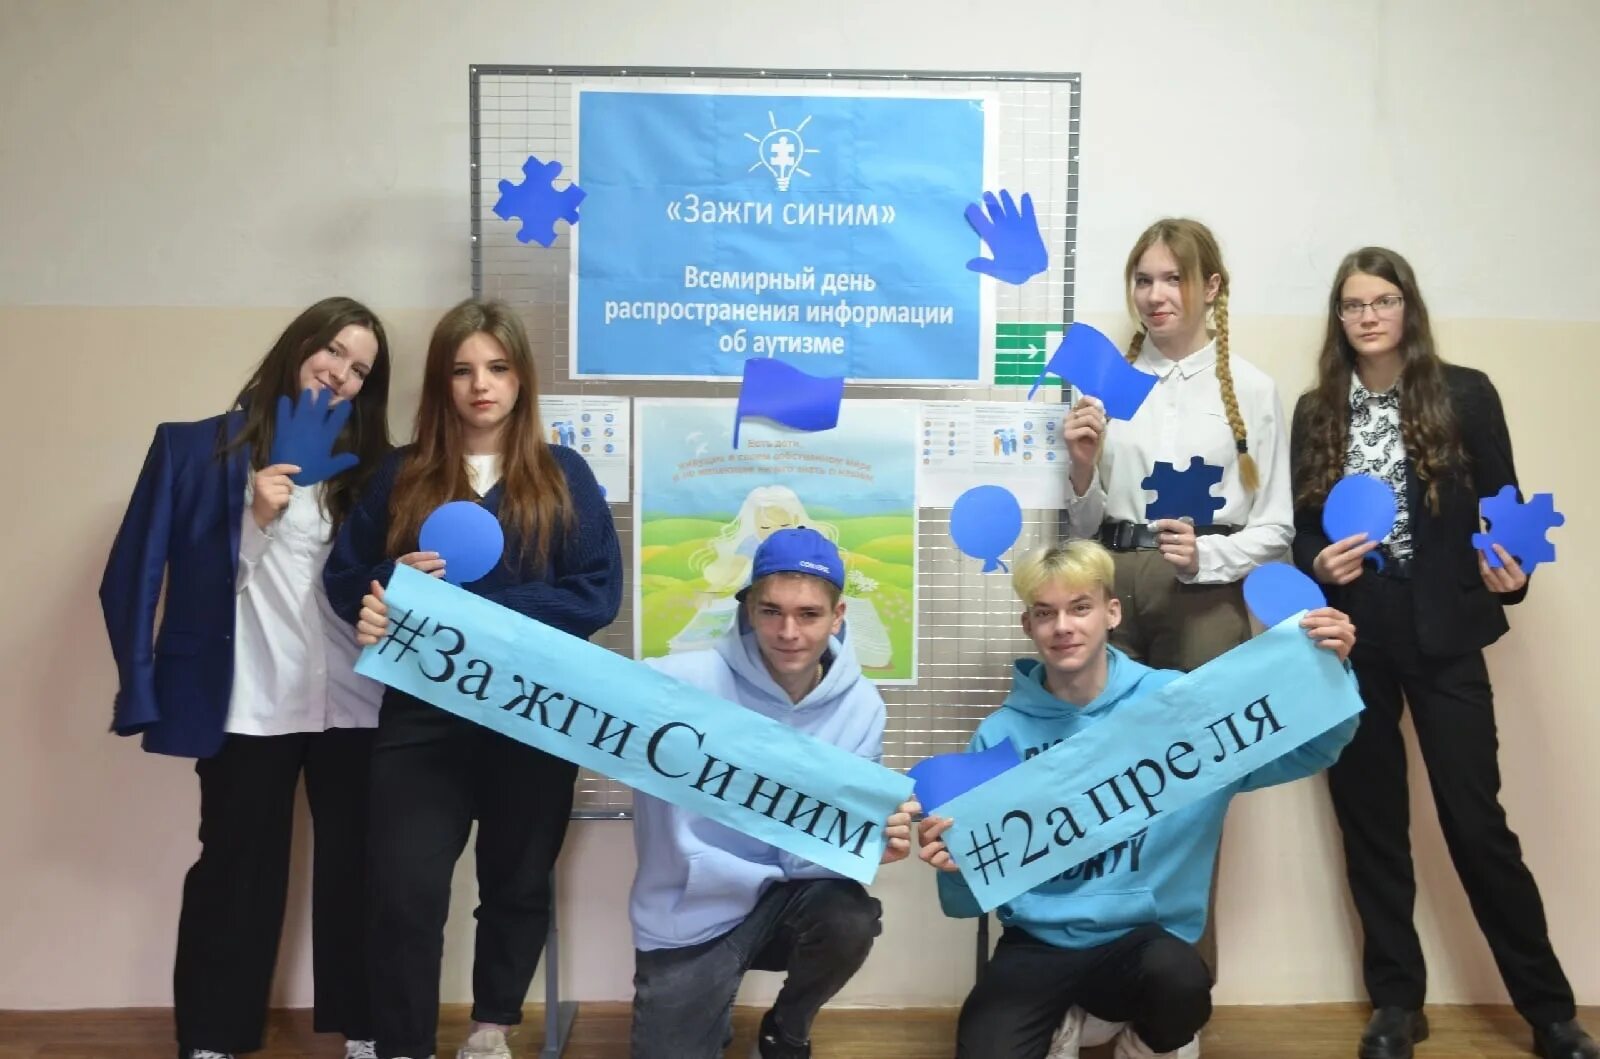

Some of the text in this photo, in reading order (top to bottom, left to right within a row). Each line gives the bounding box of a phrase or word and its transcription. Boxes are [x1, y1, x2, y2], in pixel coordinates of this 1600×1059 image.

[666, 194, 896, 226] «Зажги синим»
[684, 265, 876, 296] Всемирный день
[604, 300, 954, 328] распространения информации
[719, 329, 845, 358] об аутизме
[965, 694, 1286, 885] #2апреля
